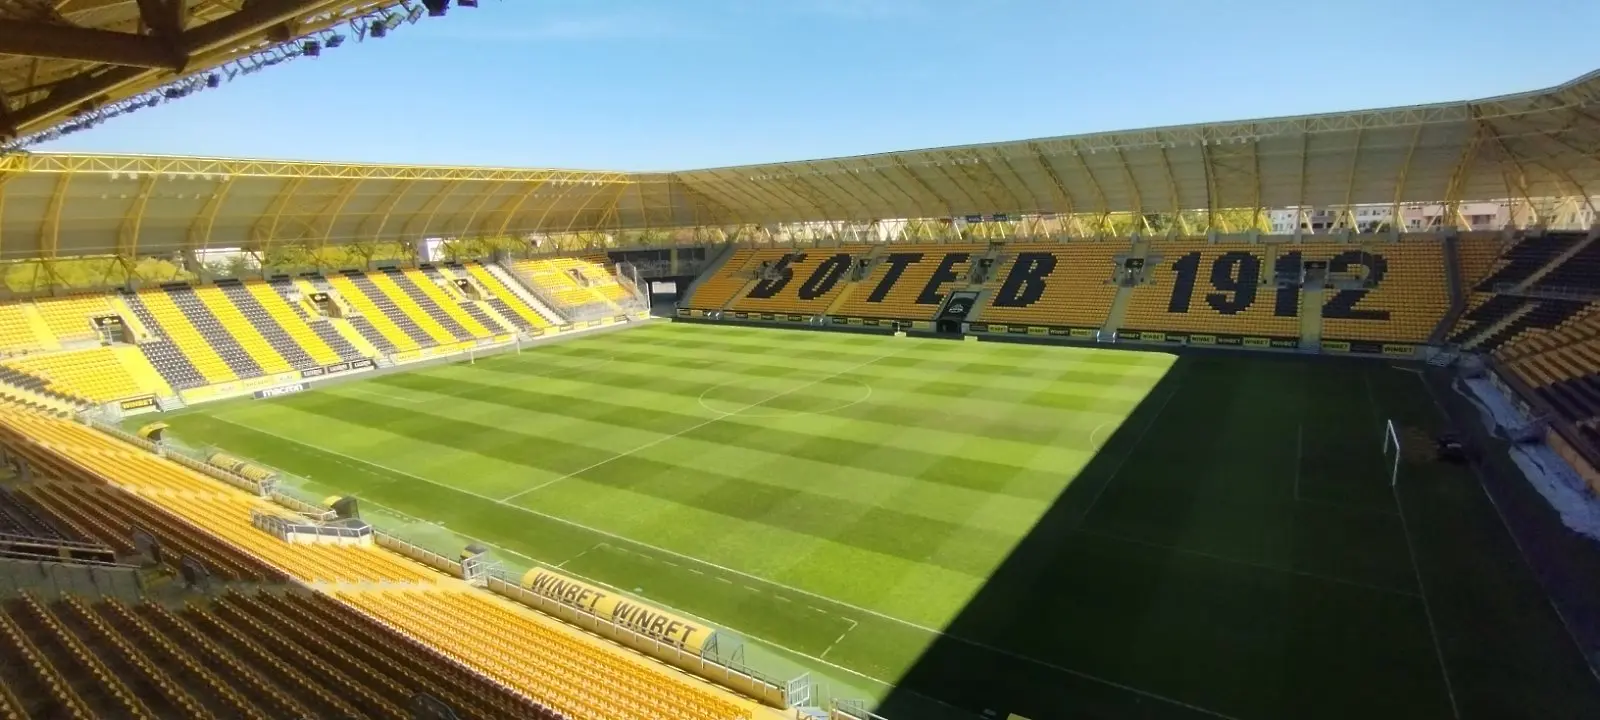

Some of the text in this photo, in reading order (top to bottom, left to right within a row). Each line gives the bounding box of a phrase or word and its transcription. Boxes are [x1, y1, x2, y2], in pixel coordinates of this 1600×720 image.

[1168, 250, 1390, 320] 1912
[530, 572, 698, 647] WINBET WINBET
